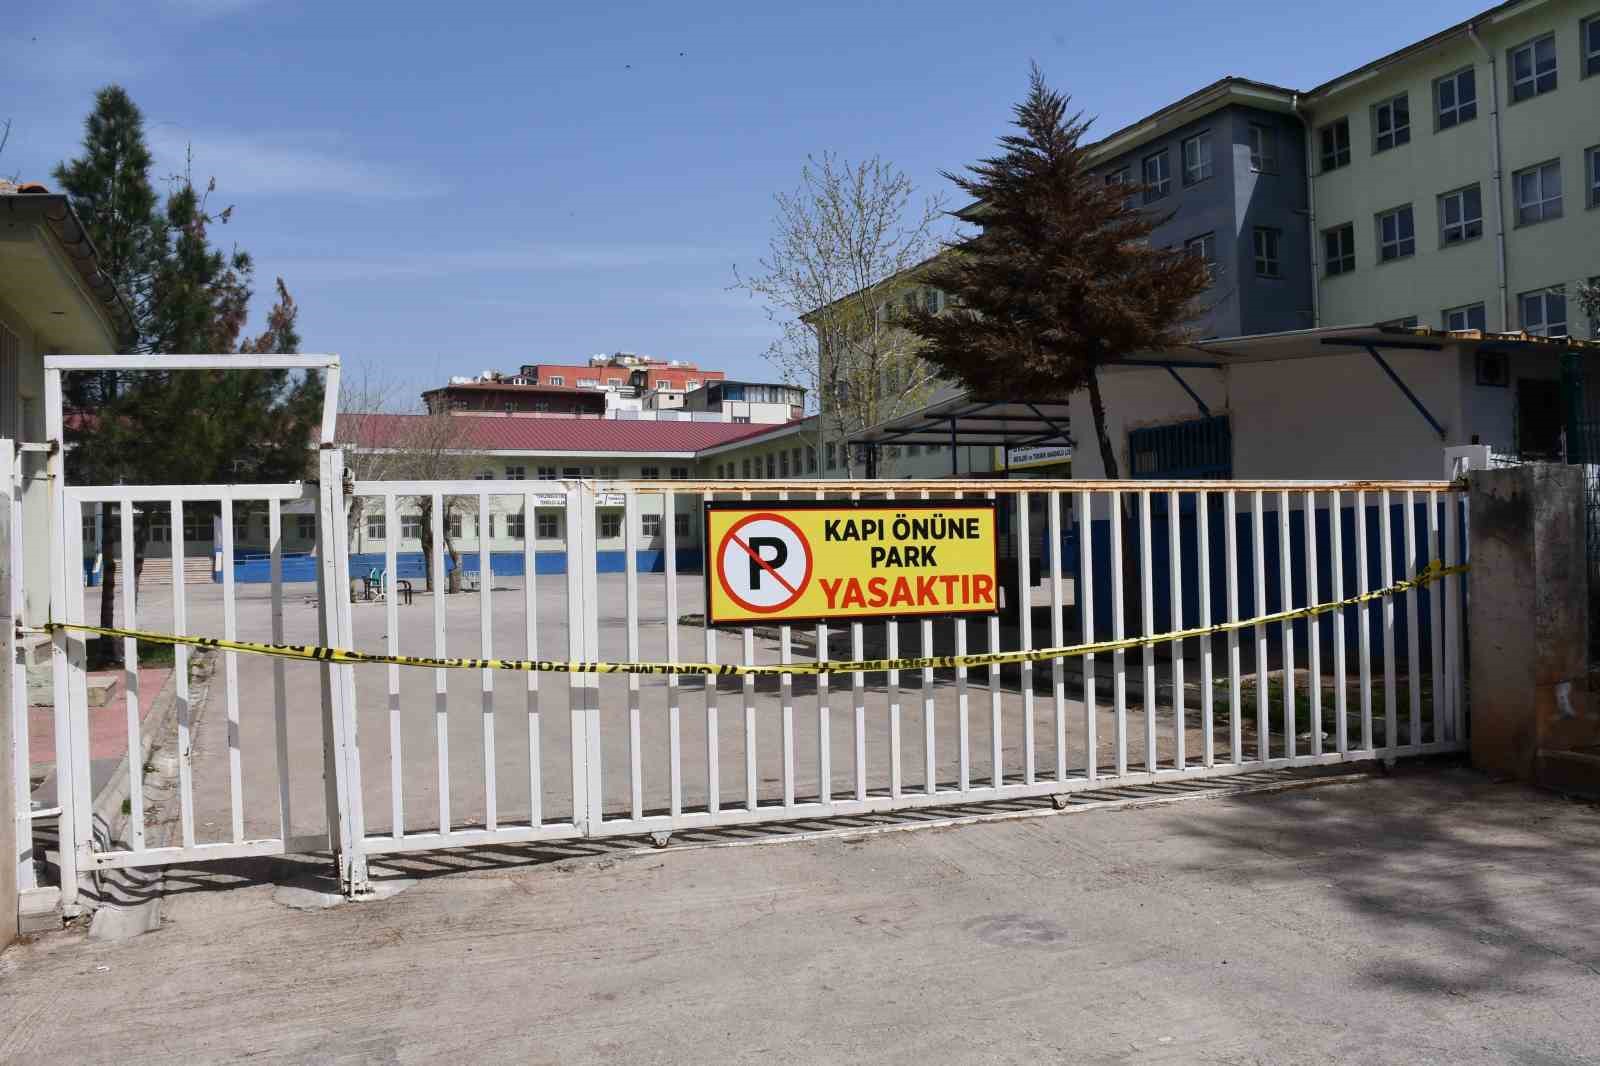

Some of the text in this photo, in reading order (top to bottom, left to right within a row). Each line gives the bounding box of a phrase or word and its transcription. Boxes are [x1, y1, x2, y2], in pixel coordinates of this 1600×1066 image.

[824, 514, 980, 542] KAPI ÖNÜNE
[749, 536, 788, 590] P
[870, 546, 937, 568] PARK
[819, 574, 993, 609] YASAKTIR
